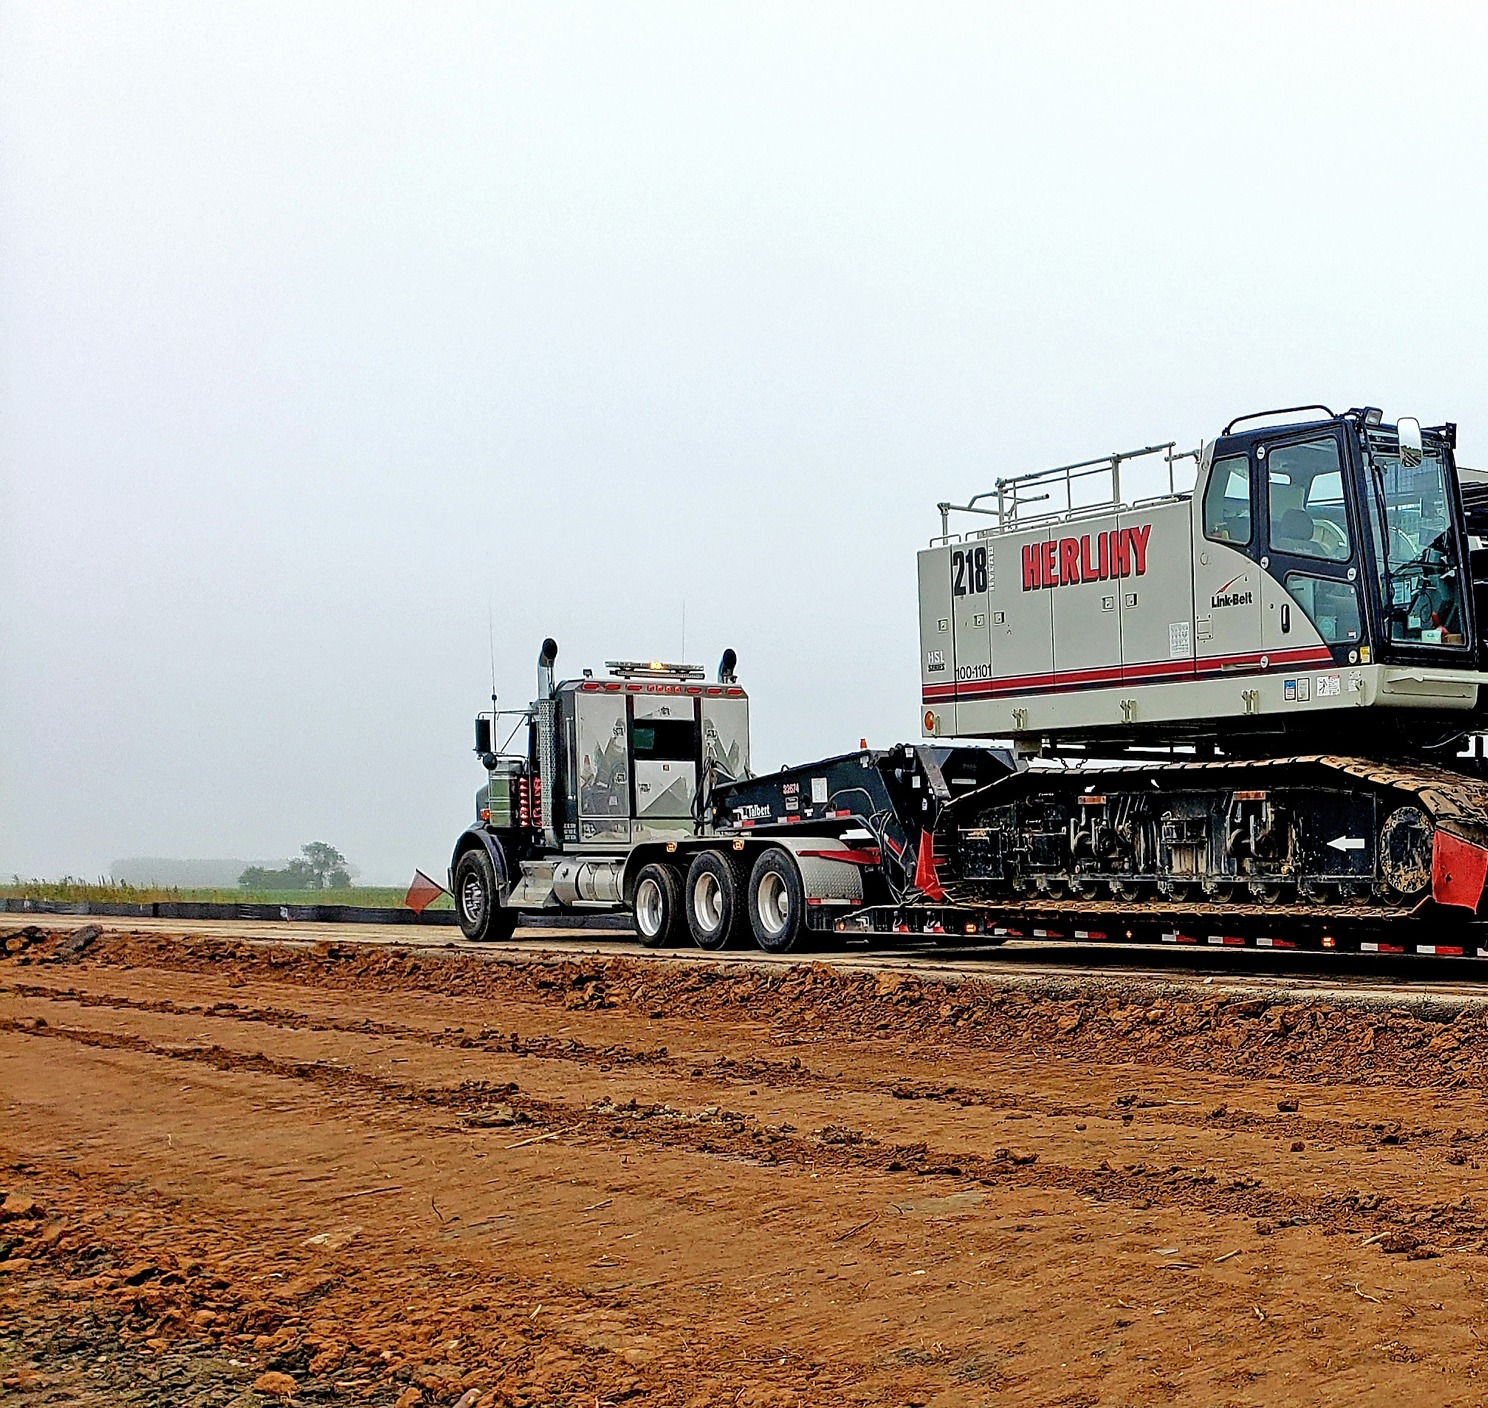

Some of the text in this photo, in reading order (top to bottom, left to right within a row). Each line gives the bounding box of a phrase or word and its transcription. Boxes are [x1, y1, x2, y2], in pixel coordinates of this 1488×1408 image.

[1021, 524, 1152, 592] HERLIHY
[953, 547, 988, 596] 218
[1211, 591, 1252, 608] Link-Belt
[927, 650, 945, 664] HSL
[928, 663, 945, 672] SERIES
[956, 664, 992, 680] 100-1101
[746, 804, 771, 818] Talbert
